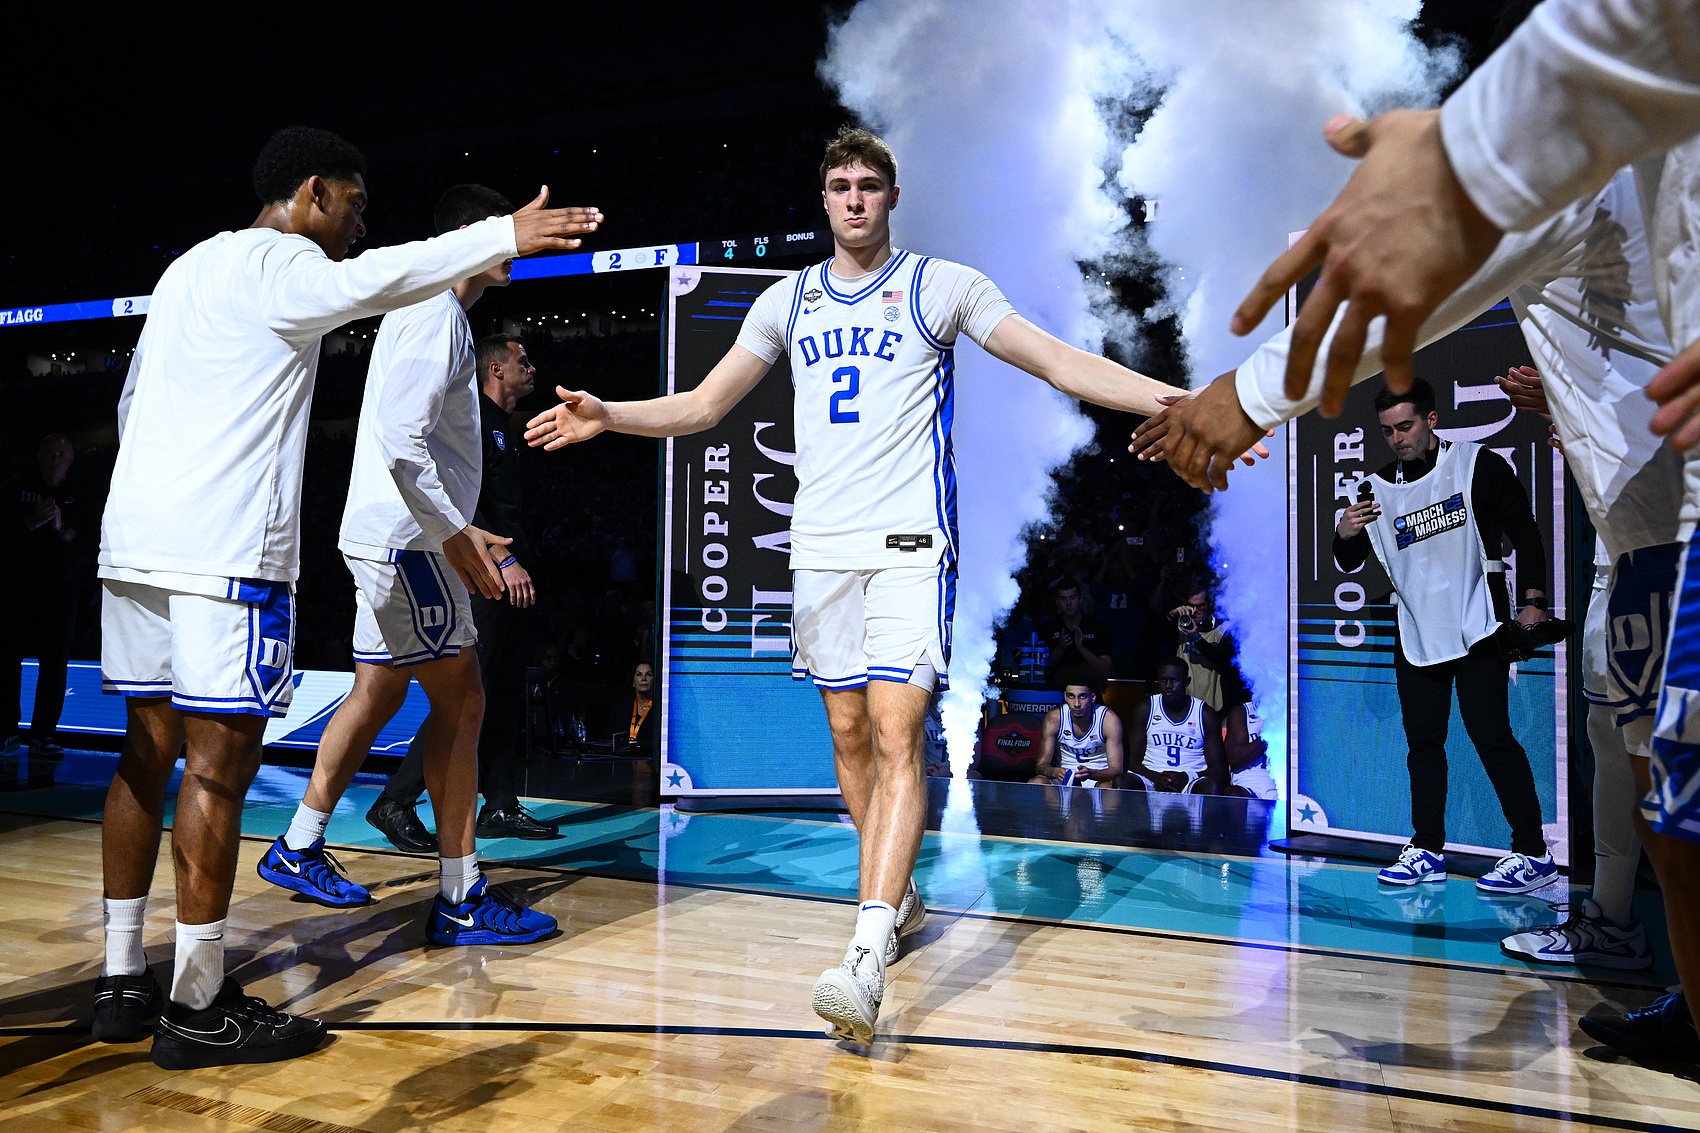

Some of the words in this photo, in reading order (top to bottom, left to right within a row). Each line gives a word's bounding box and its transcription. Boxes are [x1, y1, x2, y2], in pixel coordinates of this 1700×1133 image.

[722, 240, 738, 248] TOL
[754, 236, 769, 245] FLS
[786, 231, 815, 242] BONUS
[724, 247, 734, 260] 4
[755, 244, 766, 257] 0
[609, 252, 622, 270] 2
[653, 249, 668, 266] F
[0, 308, 43, 325] FLAGG
[124, 299, 133, 314] 2
[798, 326, 903, 367] DUKE
[829, 365, 860, 424] 2
[1405, 503, 1445, 528] MARCH
[1414, 508, 1466, 538] MADNESS
[701, 443, 730, 632] COOPER
[1334, 427, 1366, 648] COER
[997, 738, 1014, 747] FINAL
[1014, 739, 1031, 748] FOUR
[1152, 733, 1197, 750] DUKE
[1166, 745, 1181, 767] 9
